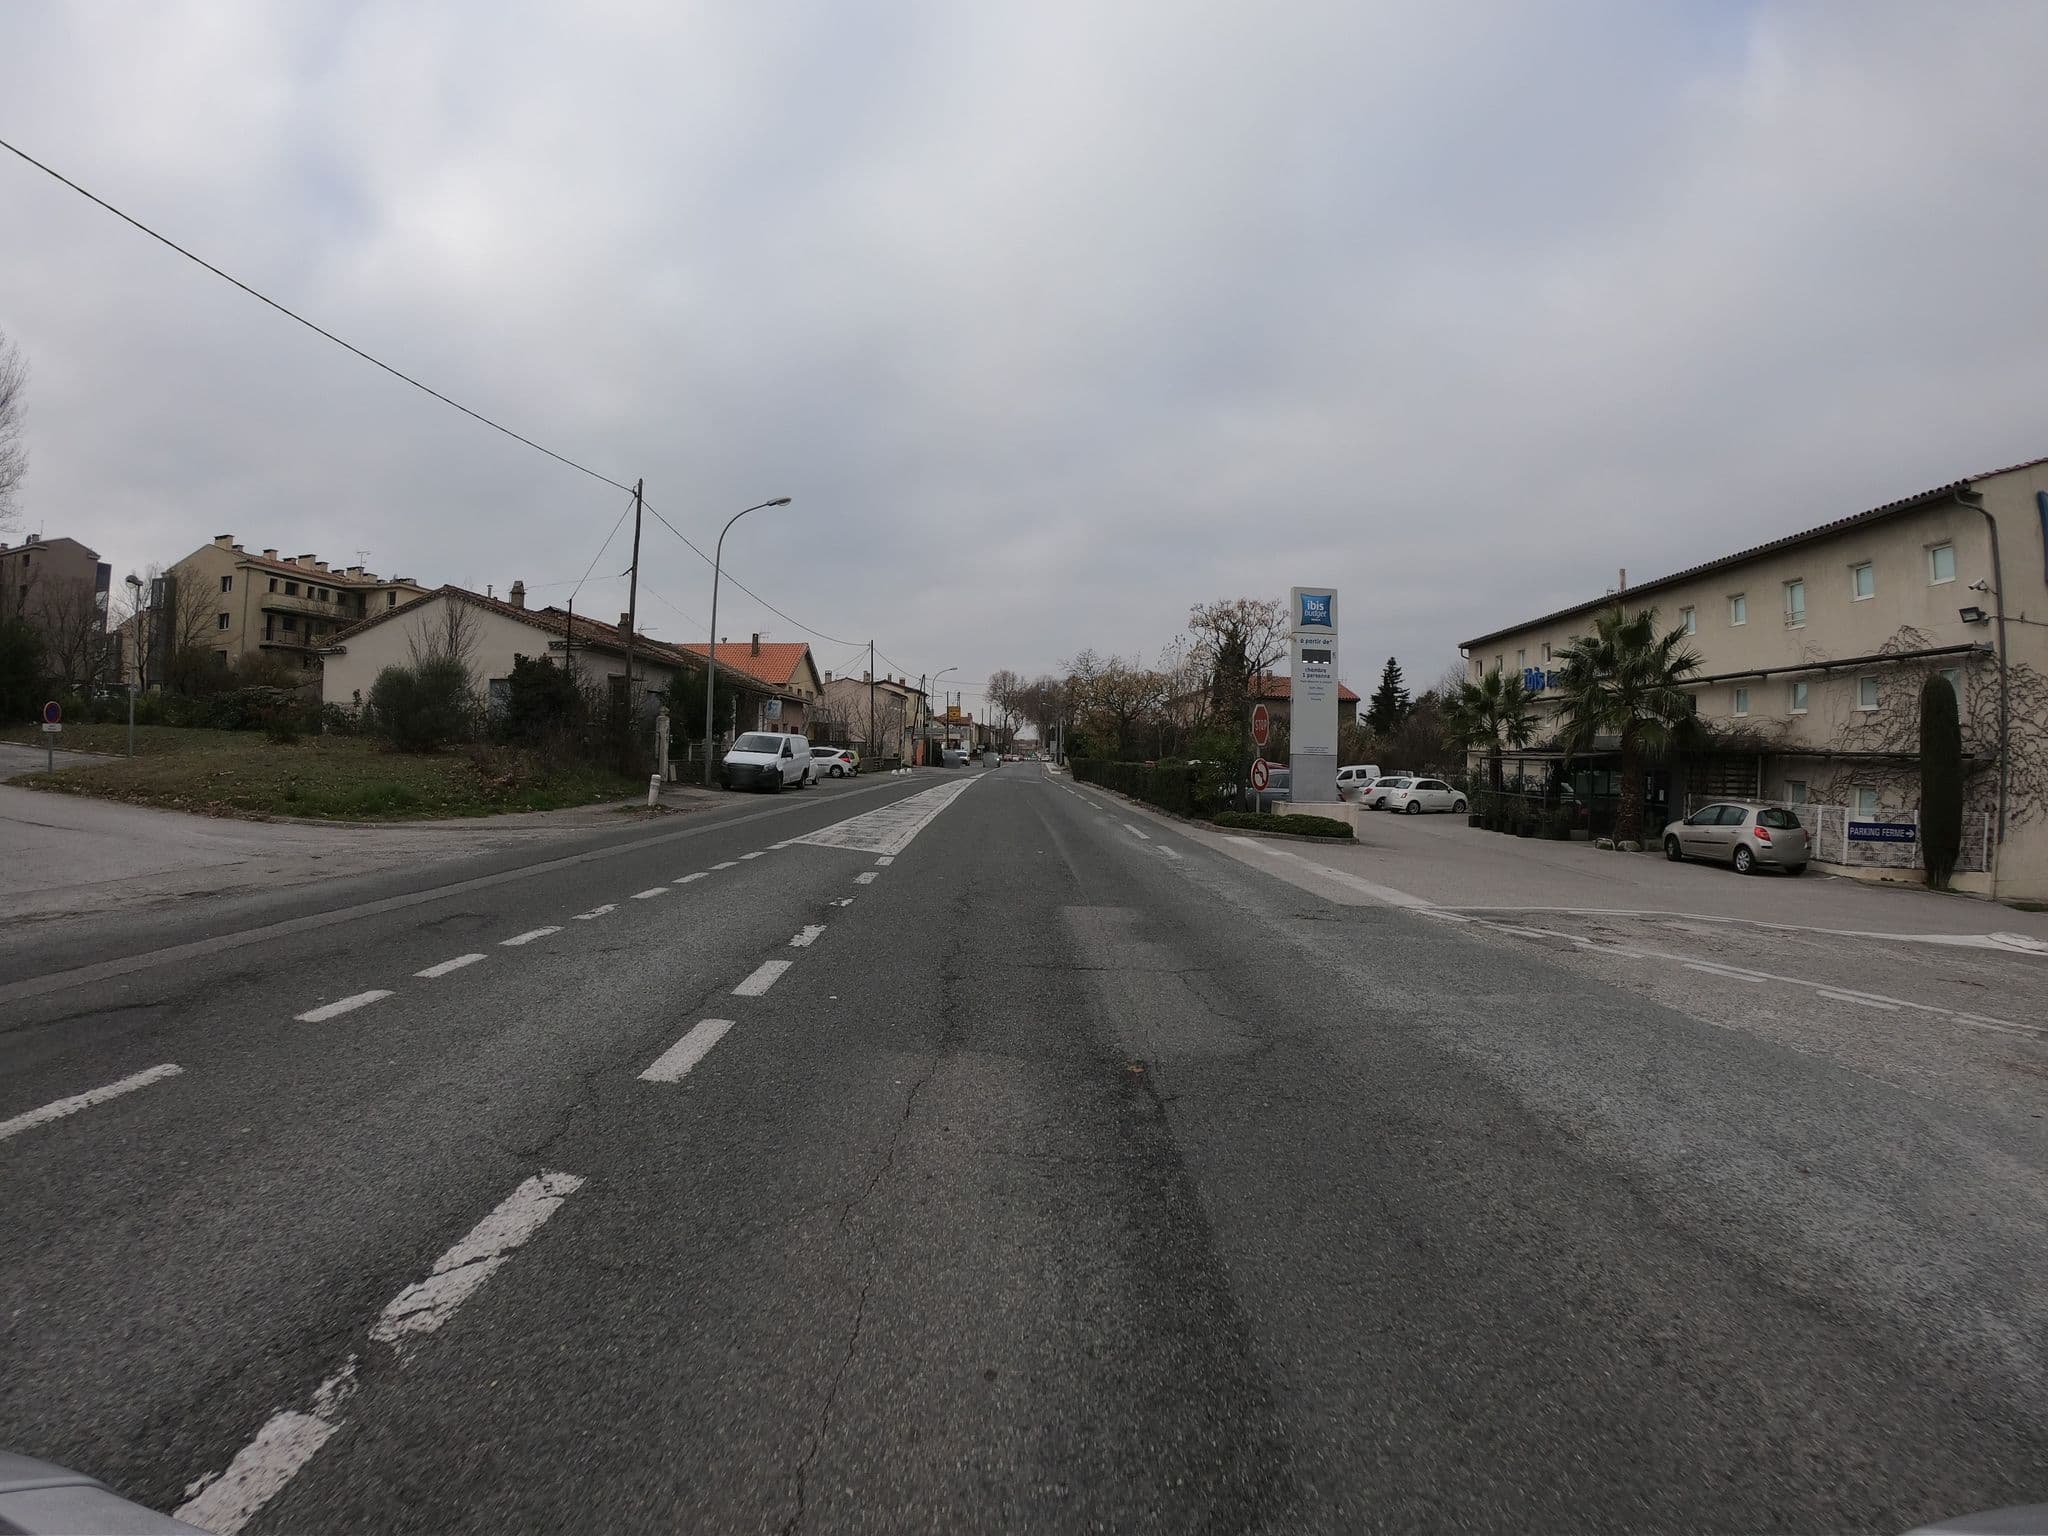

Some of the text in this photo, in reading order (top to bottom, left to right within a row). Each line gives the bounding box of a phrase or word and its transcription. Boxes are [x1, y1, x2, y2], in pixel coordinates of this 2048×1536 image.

[1307, 600, 1325, 611] ibis
[1304, 610, 1327, 619] budget
[1524, 666, 1545, 690] ibis
[1254, 719, 1269, 731] STOP
[1849, 827, 1880, 837] PARKING
